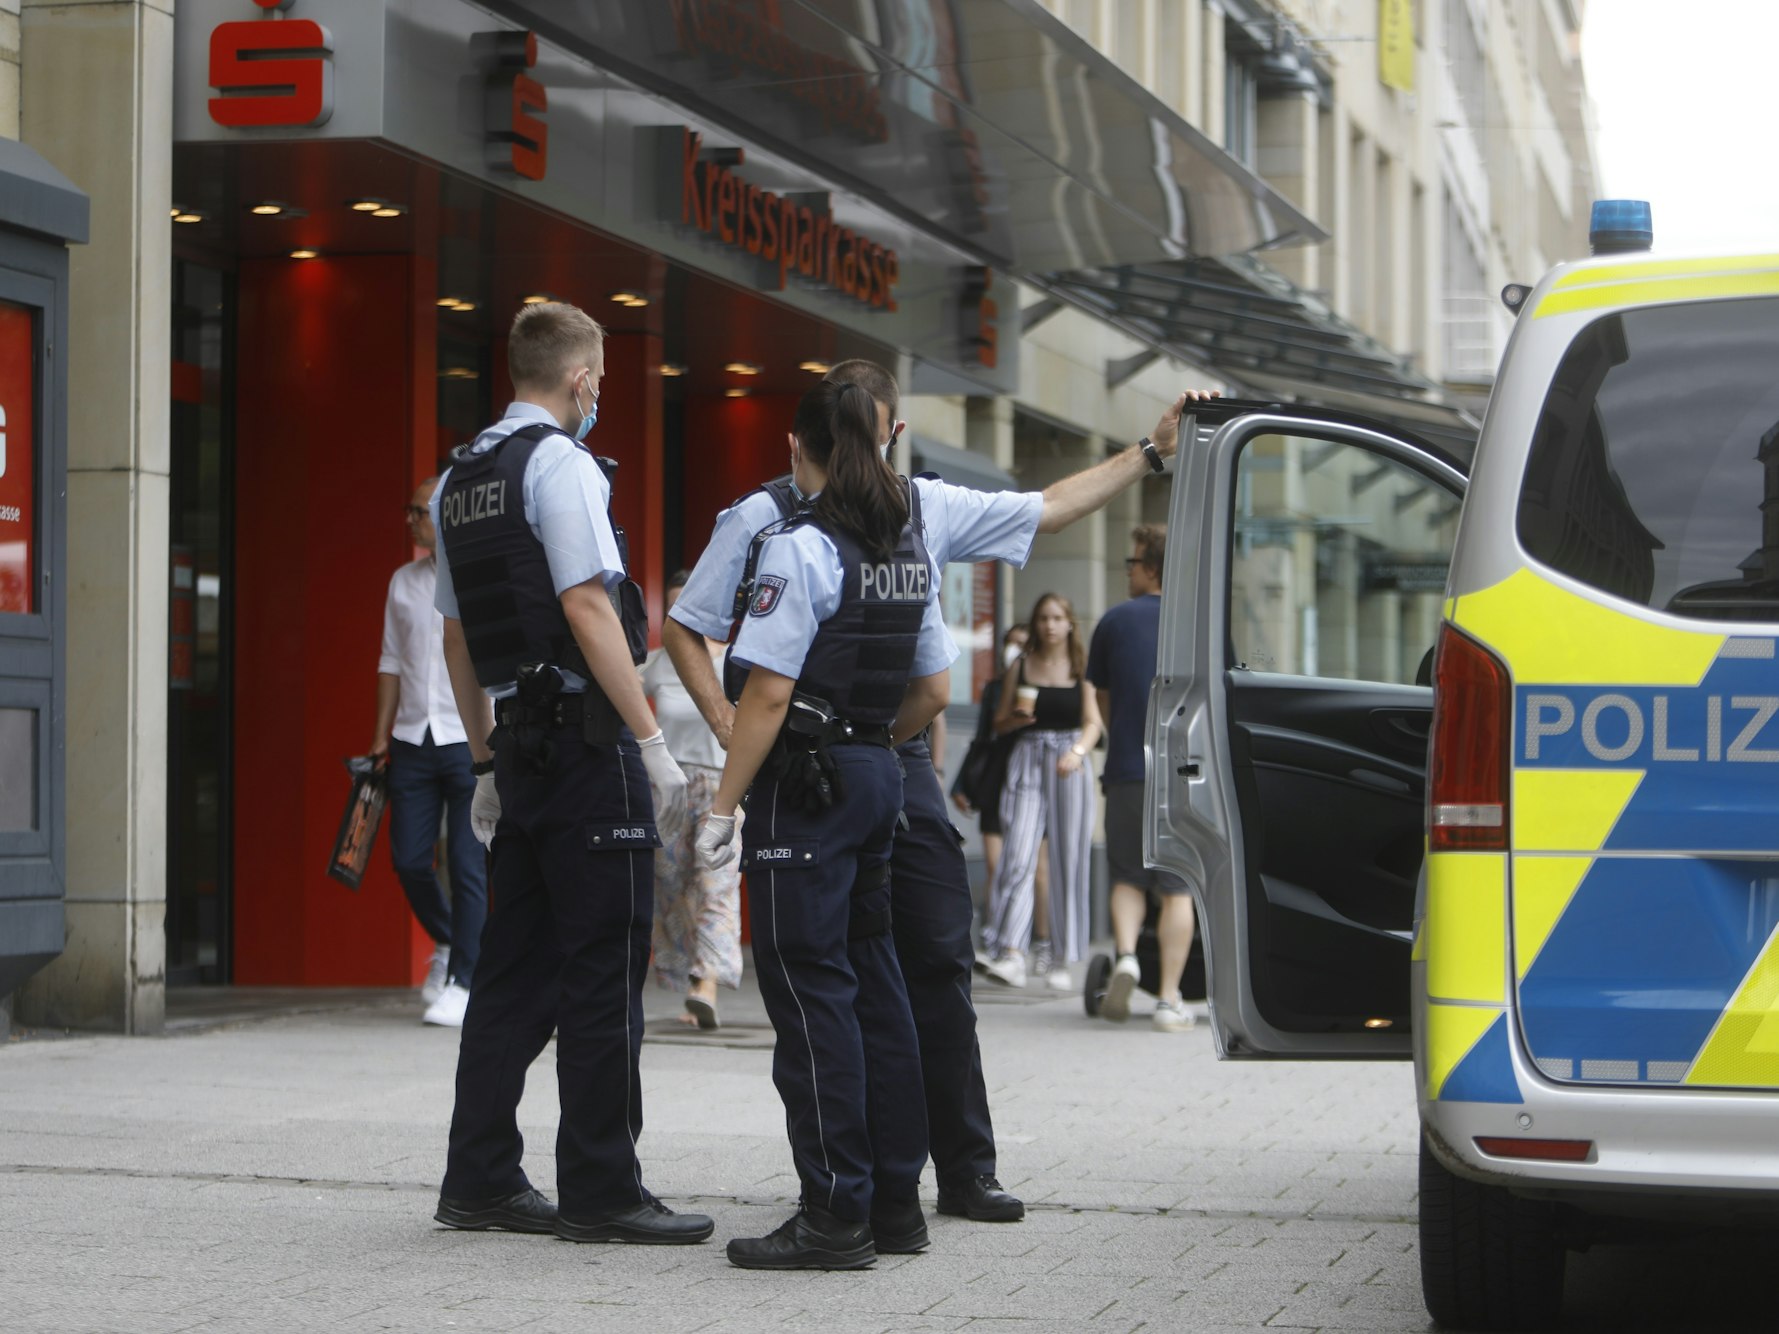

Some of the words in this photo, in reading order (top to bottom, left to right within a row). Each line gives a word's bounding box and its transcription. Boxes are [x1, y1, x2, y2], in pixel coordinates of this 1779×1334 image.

[682, 125, 899, 313] Kreissparkasse
[0, 504, 20, 522] asse
[443, 480, 506, 531] POLIZEI
[860, 563, 929, 600] POLIZEI
[1525, 694, 1779, 762] POLIZ
[613, 828, 646, 839] POLIZEI
[756, 849, 792, 860] POLIZEI
